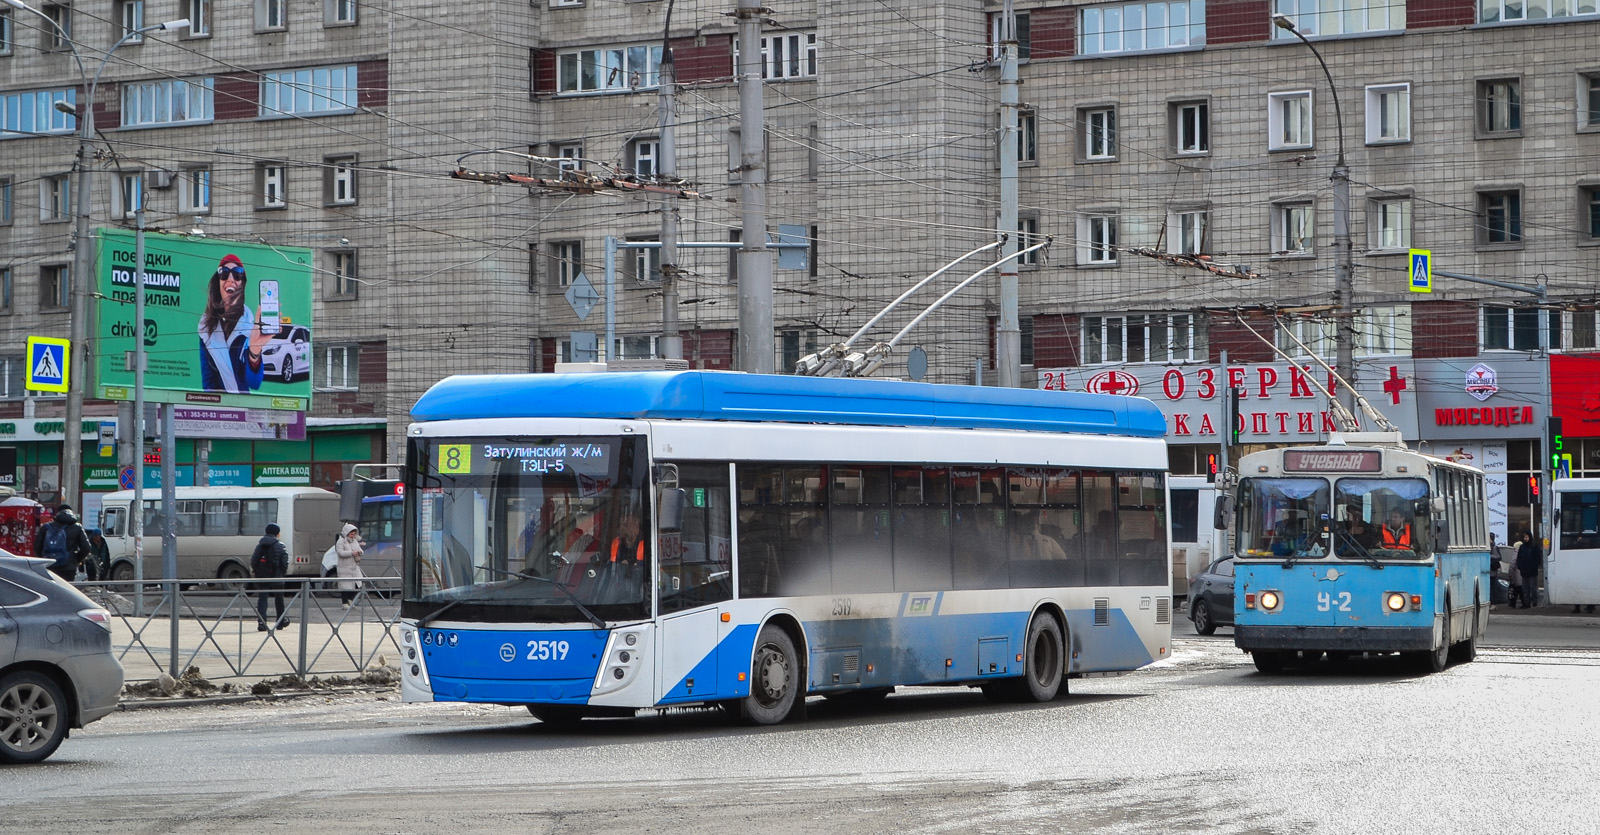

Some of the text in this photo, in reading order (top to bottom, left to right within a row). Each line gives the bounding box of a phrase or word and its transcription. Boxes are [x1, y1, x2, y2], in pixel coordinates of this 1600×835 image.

[112, 249, 172, 267] поедки
[112, 269, 180, 288] по ашим
[112, 290, 180, 307] праилам
[1043, 372, 1066, 391] 24
[1434, 405, 1534, 428] МЯСОДЕЛ
[484, 443, 603, 459] Затулинский ж/м
[1555, 435, 1563, 450] 5
[446, 447, 461, 470] 8
[520, 459, 565, 474] ТЭЦ-5
[1299, 453, 1364, 470] УЧЕБНЫЙ
[91, 469, 117, 477] АПТЕКА
[262, 467, 310, 476] АПТЕКА ВХОД
[1211, 464, 1217, 474] 8
[832, 597, 852, 616] 2519
[1317, 591, 1352, 612] У-2
[526, 640, 570, 661] 2519
